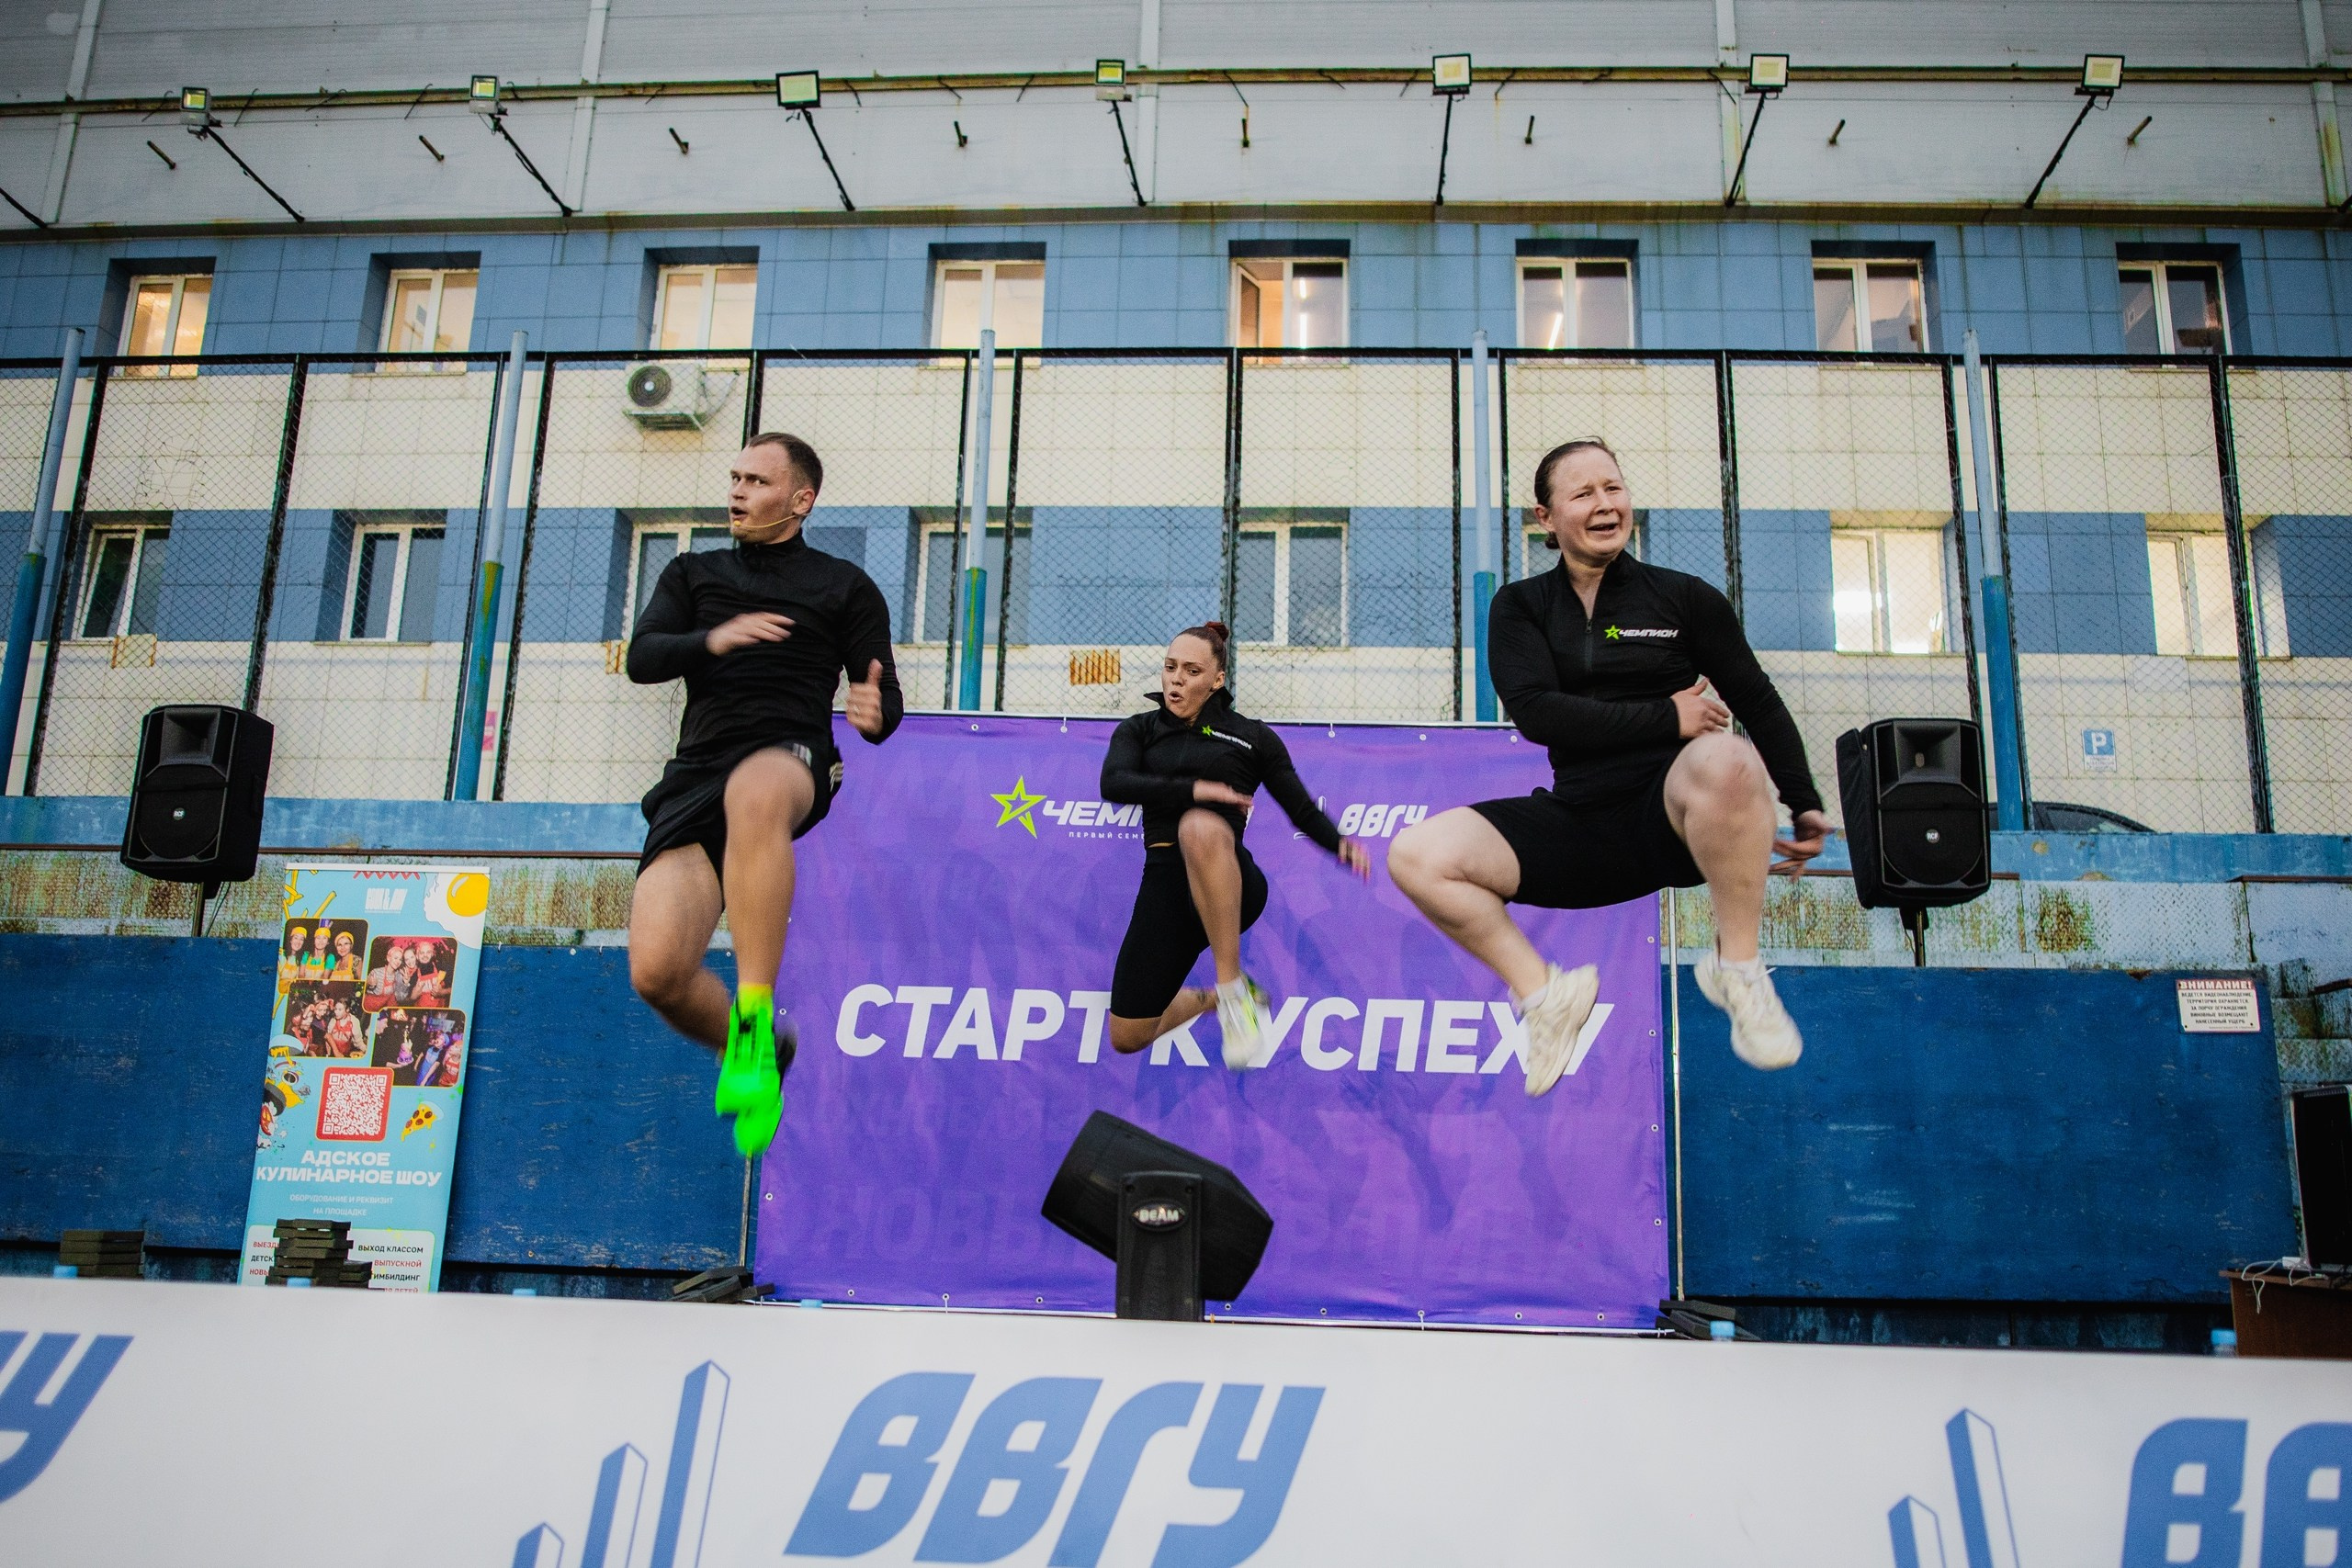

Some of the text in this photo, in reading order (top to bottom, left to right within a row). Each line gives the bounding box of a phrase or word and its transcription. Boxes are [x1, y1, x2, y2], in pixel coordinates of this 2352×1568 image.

[1619, 629, 1679, 637] ЧЕМПИОН
[1069, 831, 1113, 840] ПЕРВЫЙ
[2180, 980, 2252, 989] ВНИМАНИЕ!
[835, 983, 1112, 1064] СТАРТ
[301, 1150, 391, 1168] АДСКОЕ
[255, 1166, 442, 1187] КУЛИНАРНОЕ ШОУ
[289, 1193, 348, 1203] ОБОРУДОВАНИЕ
[356, 1195, 393, 1205] РЕКВИЗИТ
[313, 1207, 368, 1216] НА ПЛОЩАДКЕ
[1139, 1206, 1179, 1223] BEAM
[358, 1244, 424, 1254] ВЫХОД КЛАССОМ
[251, 1255, 274, 1263] ДЕТСК
[374, 1259, 422, 1268] ВЫПУСКНОЙ
[782, 1371, 1327, 1568] ВВГУ
